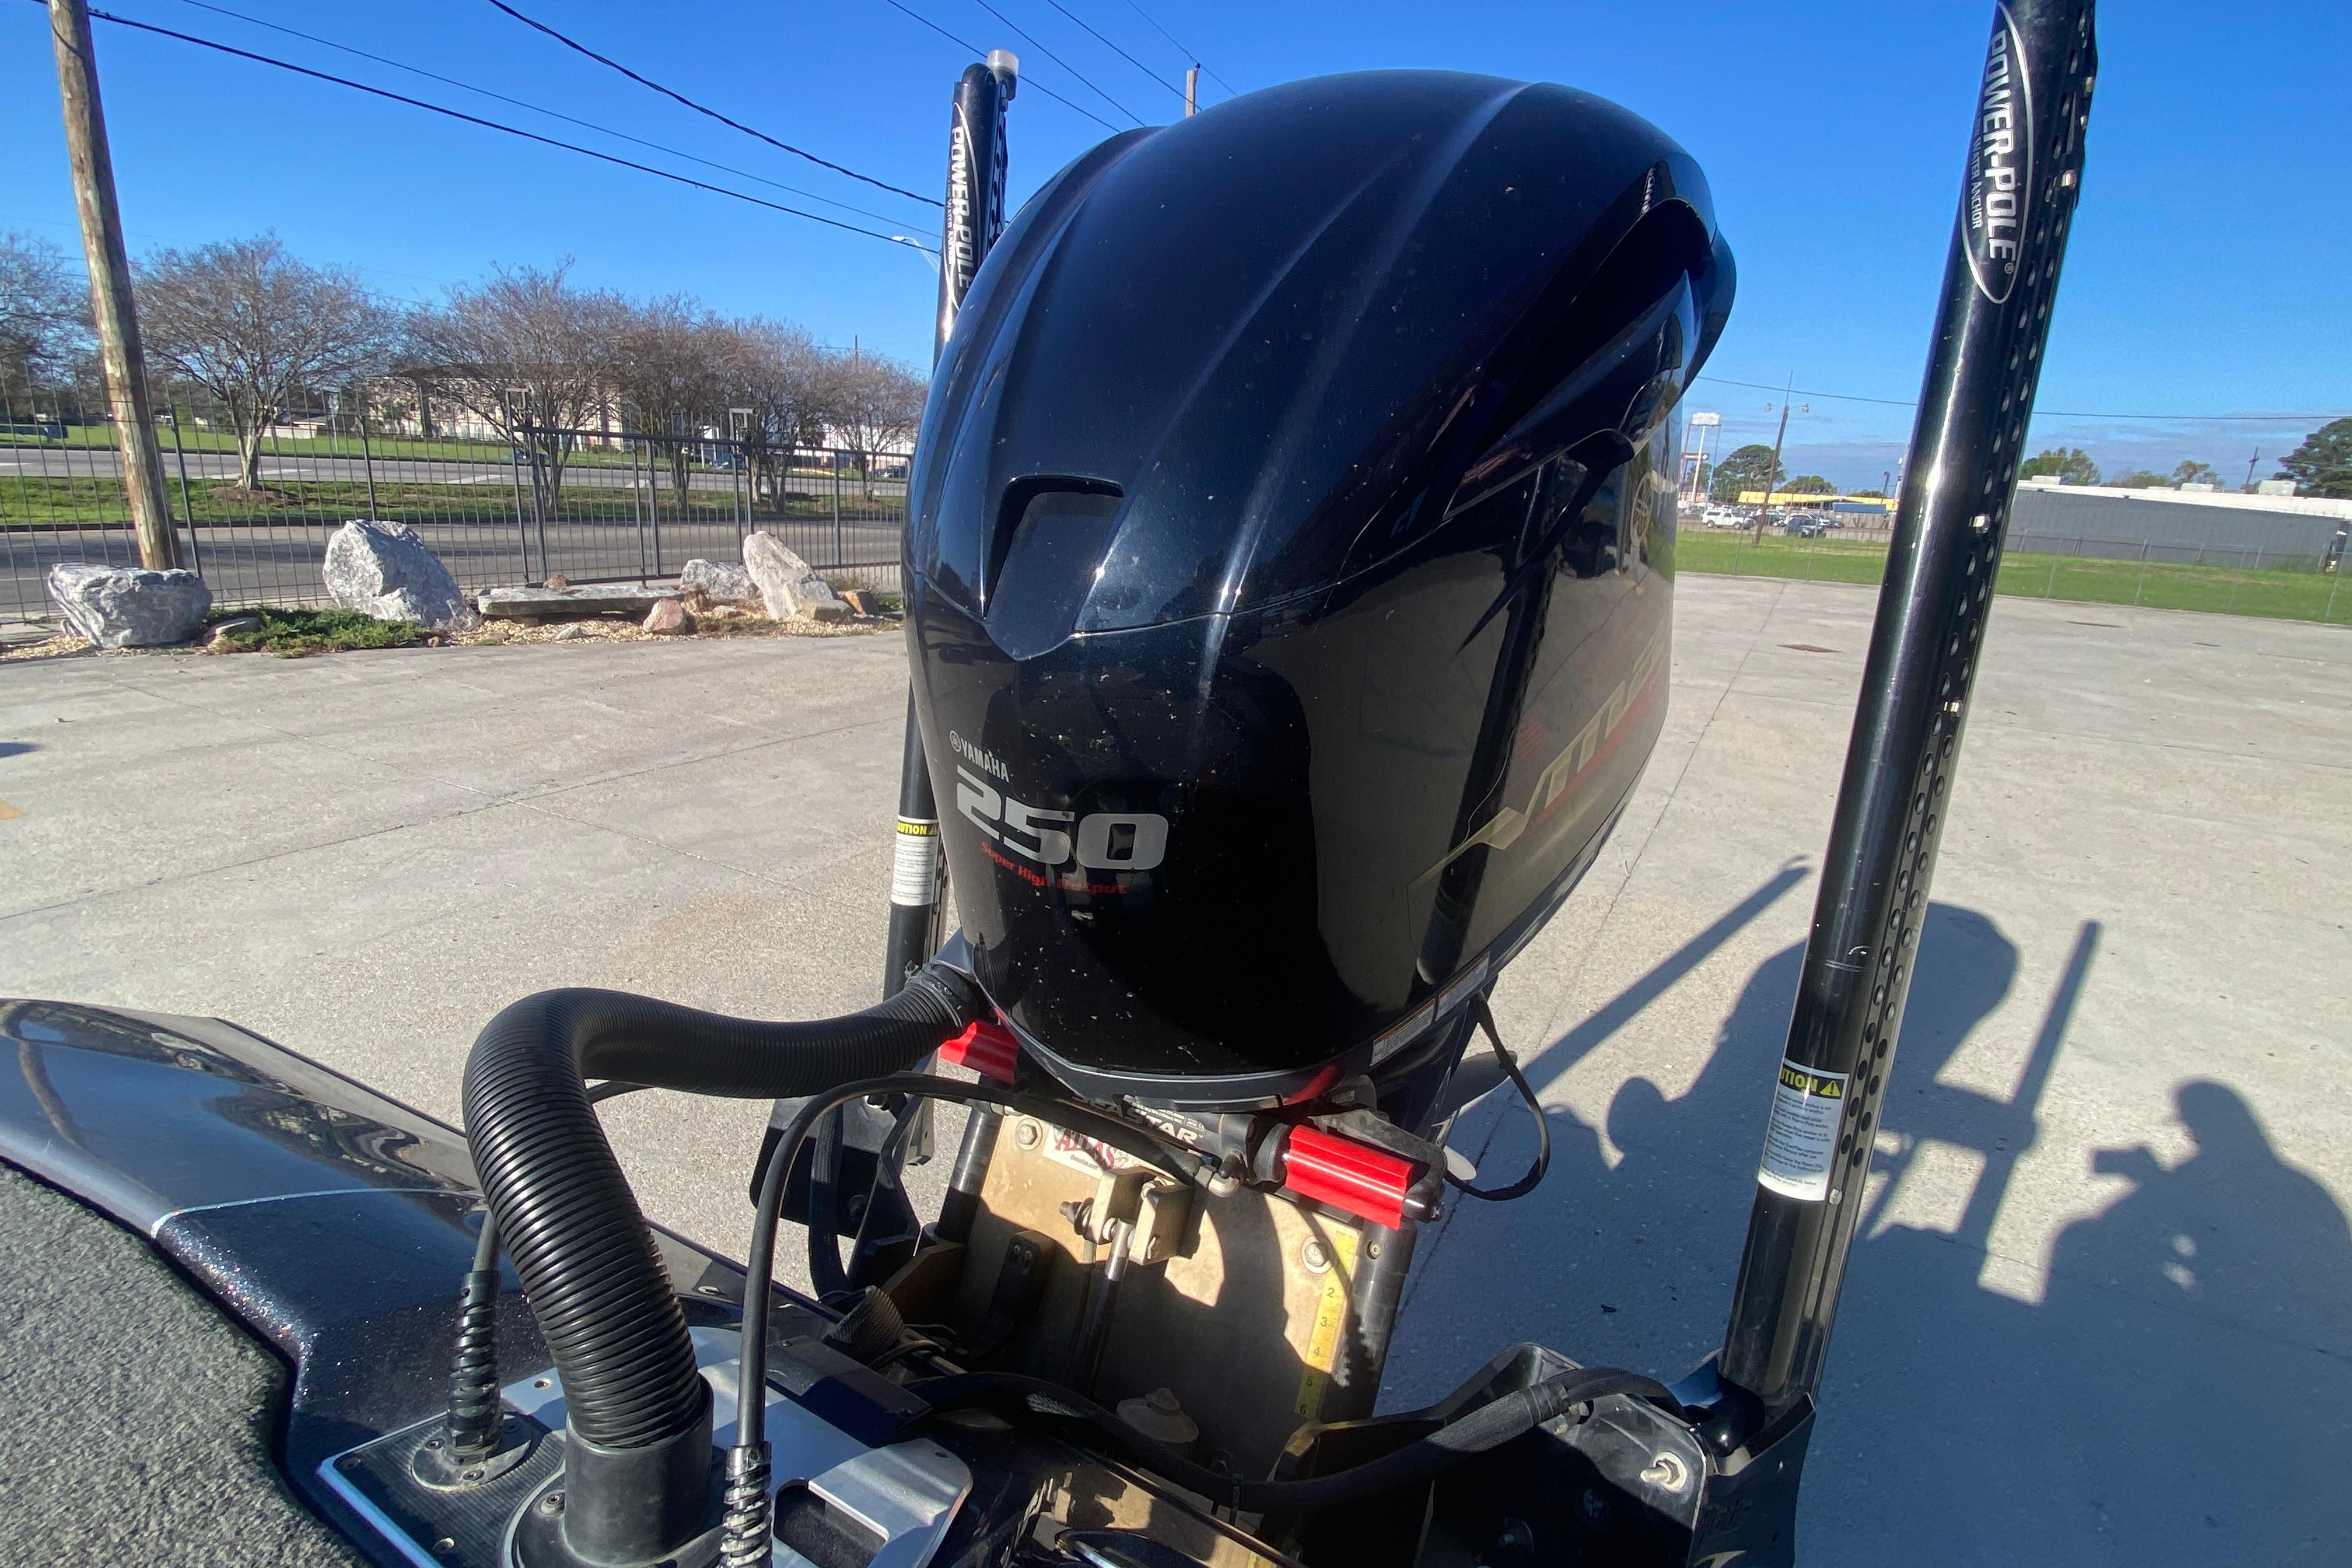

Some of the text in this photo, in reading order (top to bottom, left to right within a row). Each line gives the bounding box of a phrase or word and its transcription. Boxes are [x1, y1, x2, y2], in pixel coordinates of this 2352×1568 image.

[1971, 136, 1982, 180] WATER
[1984, 29, 2017, 261] POWER-POLE
[951, 126, 974, 288] POWER-POLE
[1971, 181, 1983, 229] ANCHOR
[960, 737, 1010, 783] YAMAHA
[897, 821, 927, 835] UTION
[957, 765, 1168, 870] 250
[982, 841, 1016, 870] Super
[1782, 1068, 1818, 1092] TION
[1326, 1287, 1335, 1298] 2
[1320, 1317, 1328, 1327] 3
[1314, 1346, 1321, 1357] 4
[1306, 1376, 1313, 1387] 5
[1300, 1404, 1307, 1415] 6
